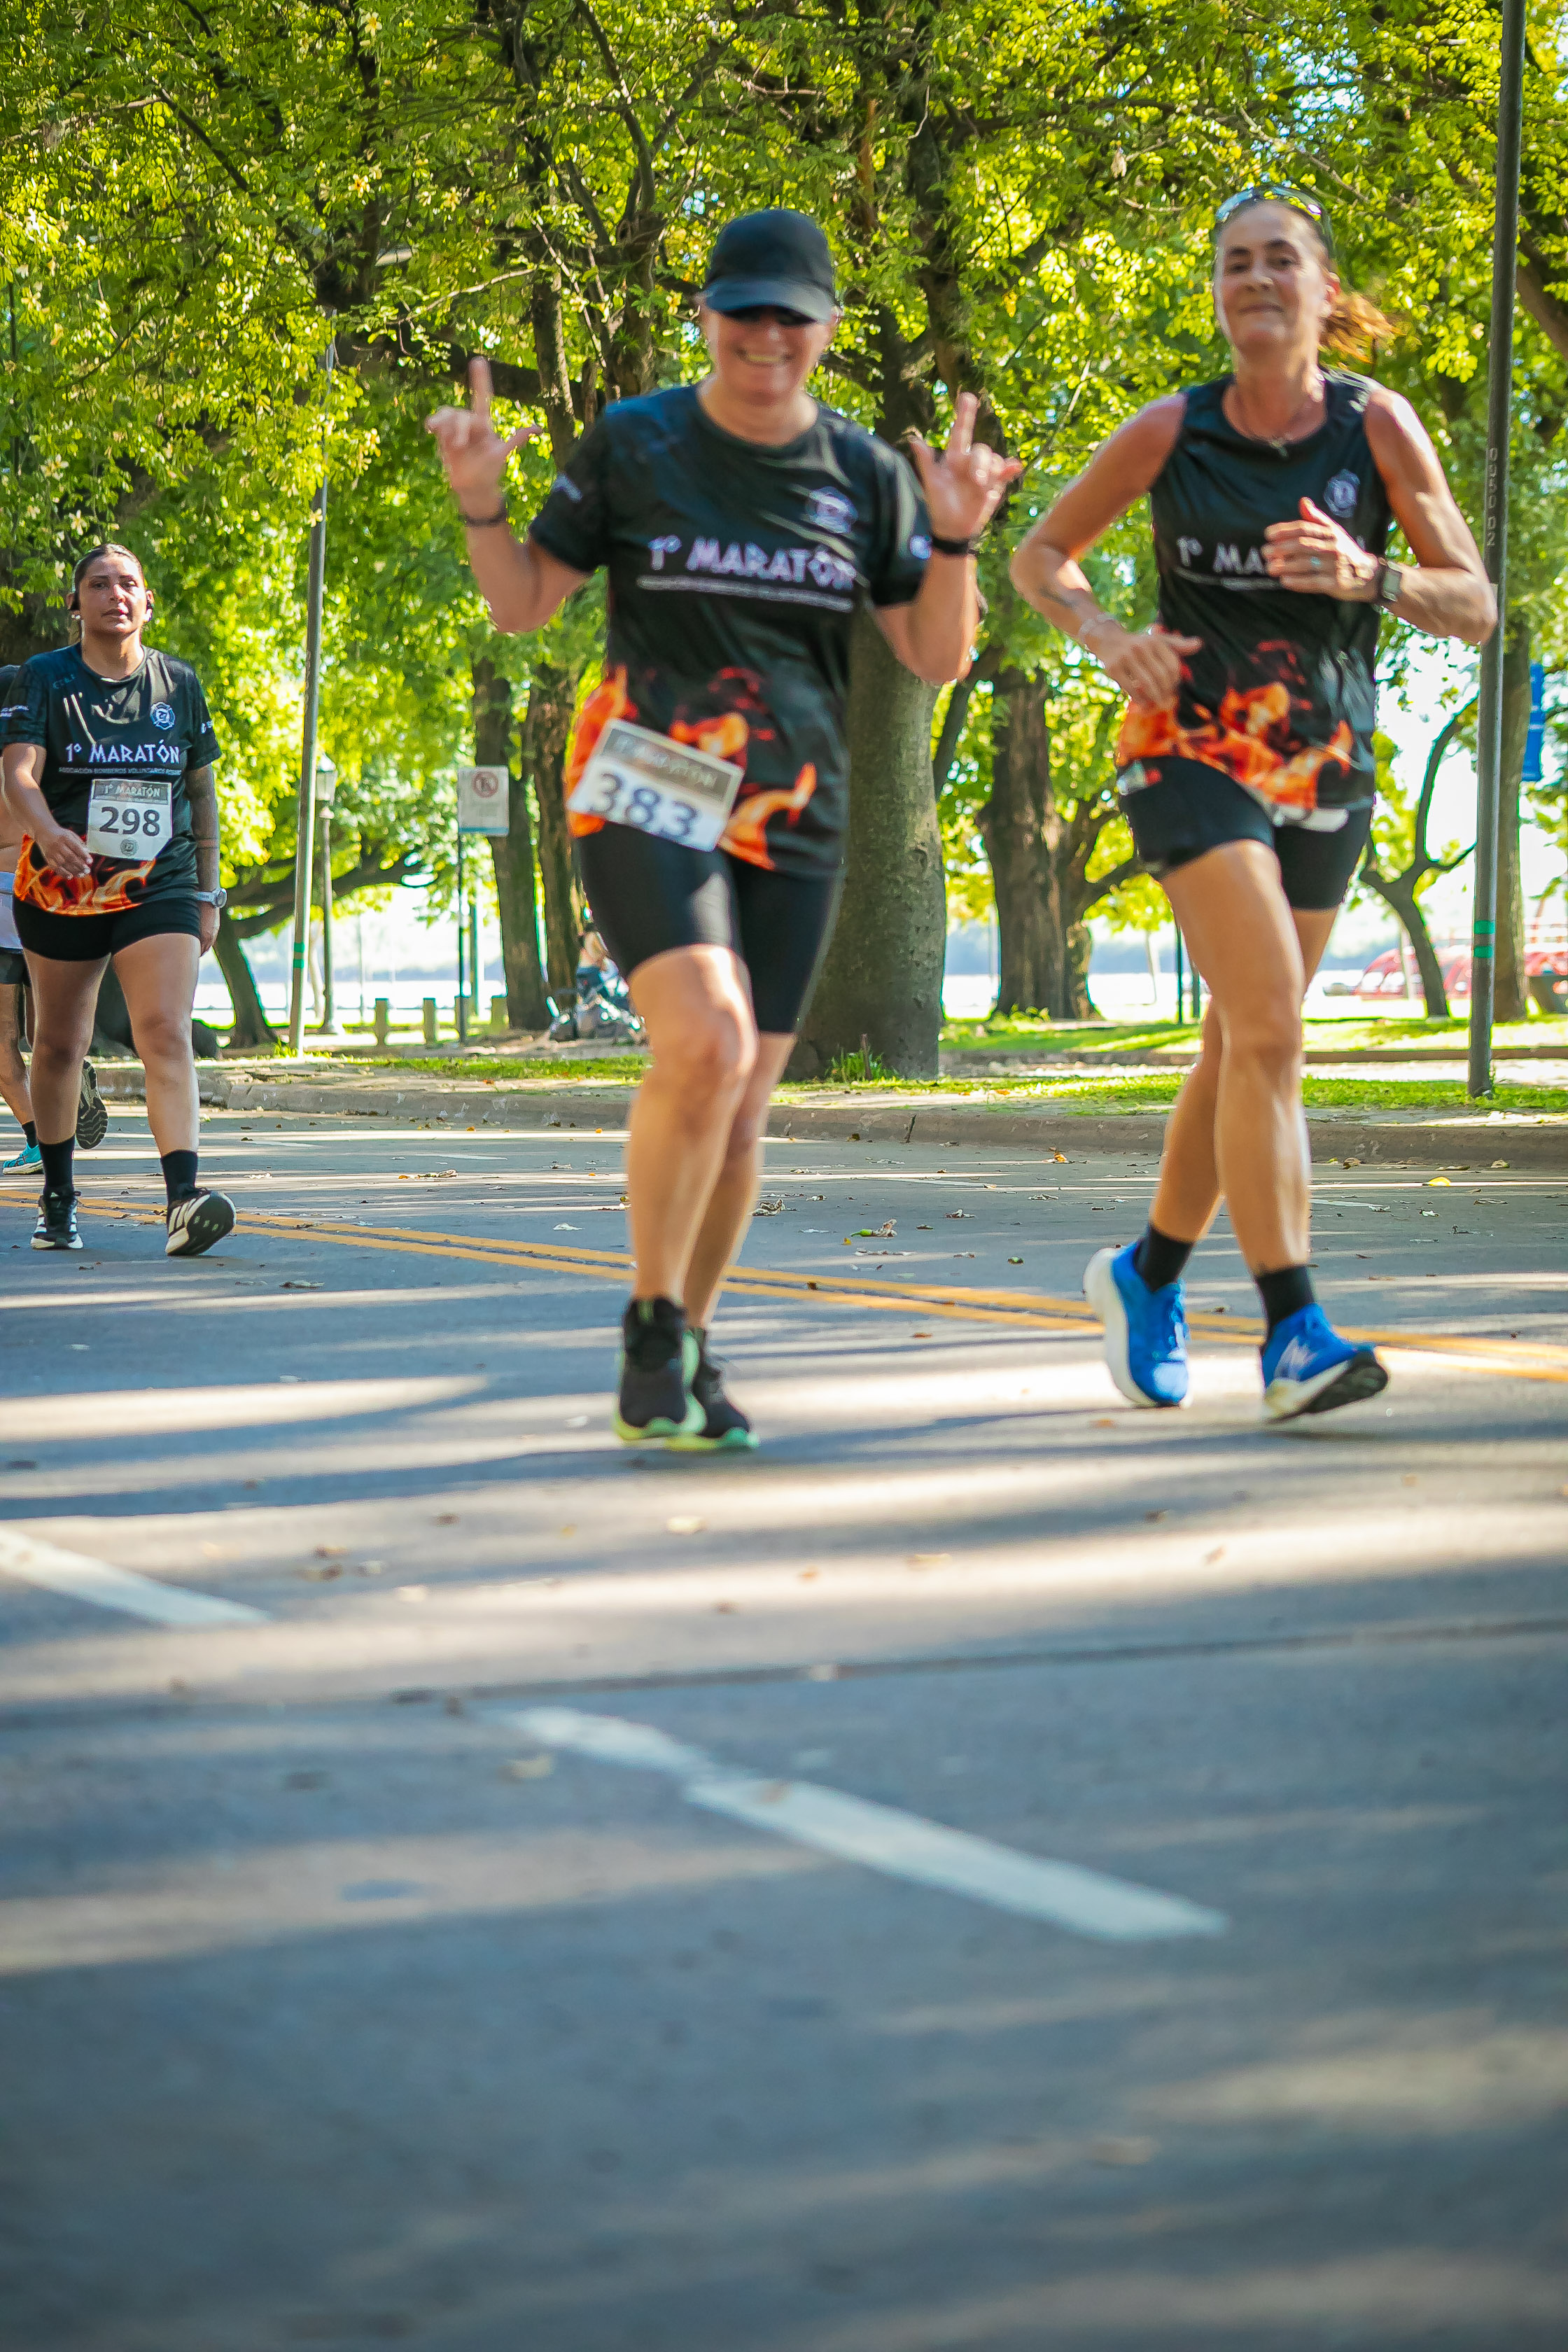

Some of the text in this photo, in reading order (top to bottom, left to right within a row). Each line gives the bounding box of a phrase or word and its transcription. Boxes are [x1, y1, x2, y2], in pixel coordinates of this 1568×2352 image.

[88, 738, 180, 764] MARATÓN
[115, 784, 161, 797] MARATÓN
[592, 772, 699, 840] 383
[99, 806, 160, 836] 298
